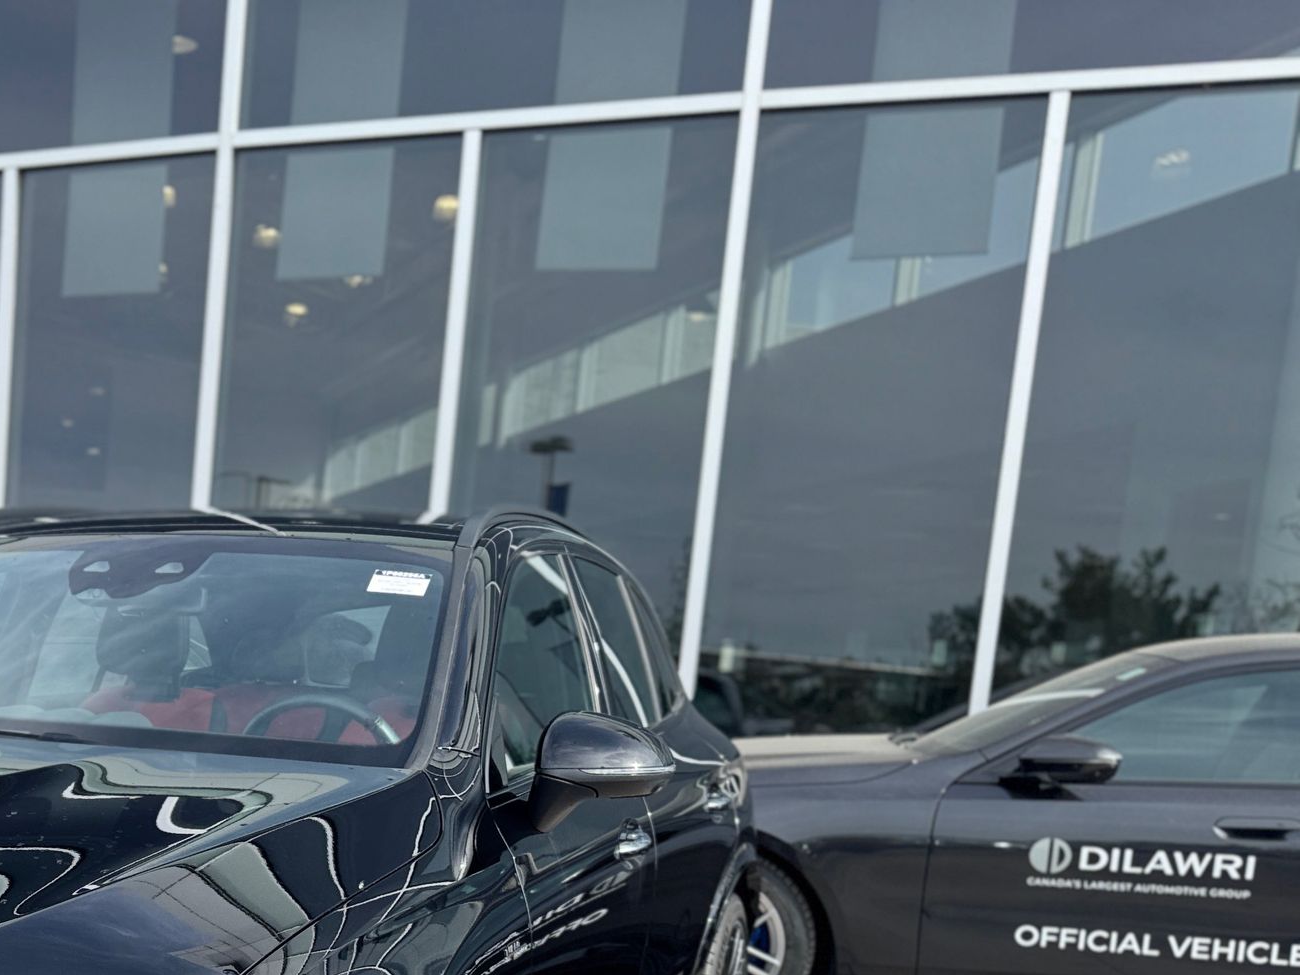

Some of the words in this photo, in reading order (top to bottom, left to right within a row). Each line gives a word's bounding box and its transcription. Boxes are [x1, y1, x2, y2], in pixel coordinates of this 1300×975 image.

[1078, 846, 1257, 881] DILAWRI
[1026, 875, 1082, 890] CANADA'S
[1083, 879, 1132, 893] LARGEST
[1133, 883, 1208, 898] AUTOMOTIVE
[1209, 887, 1252, 900] GROUP
[1013, 923, 1160, 957] OFFICIAL
